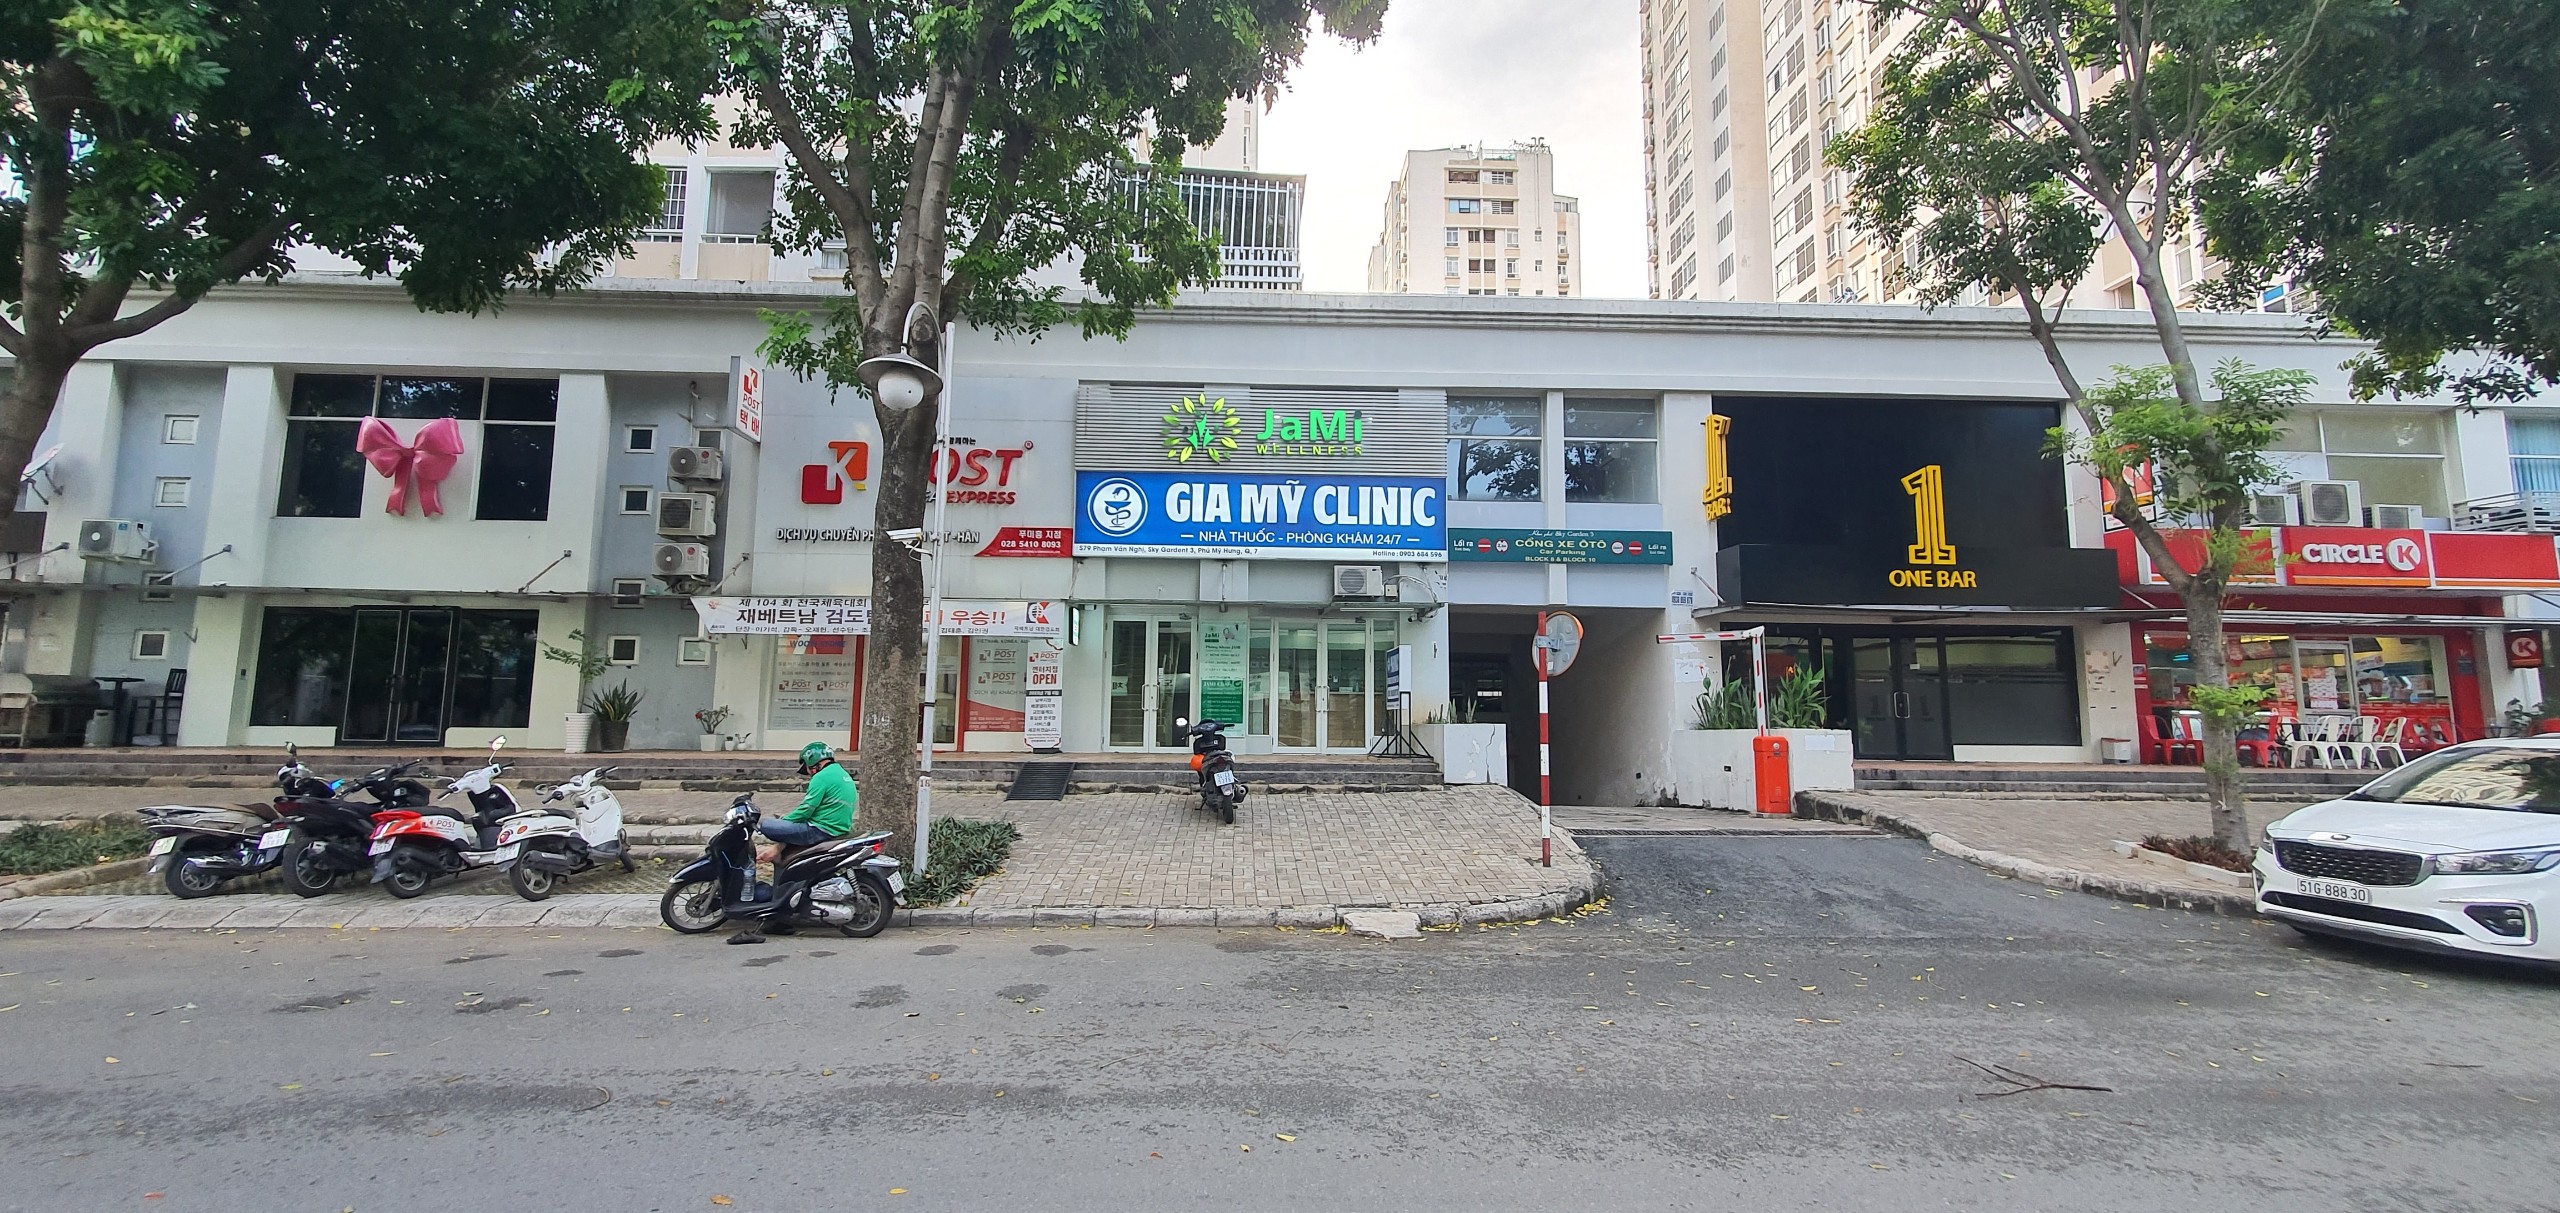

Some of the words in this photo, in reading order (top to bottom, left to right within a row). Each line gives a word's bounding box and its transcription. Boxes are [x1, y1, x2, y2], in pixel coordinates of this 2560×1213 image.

[743, 393, 760, 411] POST
[1255, 408, 1364, 443] JaMi
[1256, 445, 1364, 457] WELLNESS
[929, 449, 1024, 487] OST
[946, 490, 1017, 505] EXPRESS
[1165, 482, 1232, 524] GIA
[1240, 479, 1307, 525] MỸ
[1313, 486, 1436, 528] CLINIC
[776, 528, 804, 543] DỊCH
[804, 529, 818, 543] VỤ
[819, 526, 861, 541] CHUYỂN
[1199, 529, 1228, 543] NHÀ
[1230, 528, 1276, 544] THUỐC
[1286, 528, 1335, 546] PHÒNG
[1336, 530, 1376, 546] KHÁM
[1376, 534, 1402, 546] 24/7
[1001, 540, 1017, 548] 028
[1018, 540, 1039, 548] 5410
[1041, 540, 1061, 549] 8093
[1148, 546, 1159, 554] Sky
[1558, 540, 1577, 549] XE
[1578, 539, 1607, 549] ÔTÔ
[2301, 543, 2385, 564] CIRCLE
[1888, 569, 1934, 588] ONE
[1936, 570, 1978, 588] BAR
[756, 599, 777, 607] 104
[736, 608, 818, 625] 재베트남
[993, 650, 1017, 658] POST
[791, 680, 812, 688] POST
[992, 672, 1016, 681] POST
[1032, 673, 1058, 685] OPEN
[436, 820, 456, 828] POST
[2300, 880, 2366, 901] 51G-888.30
